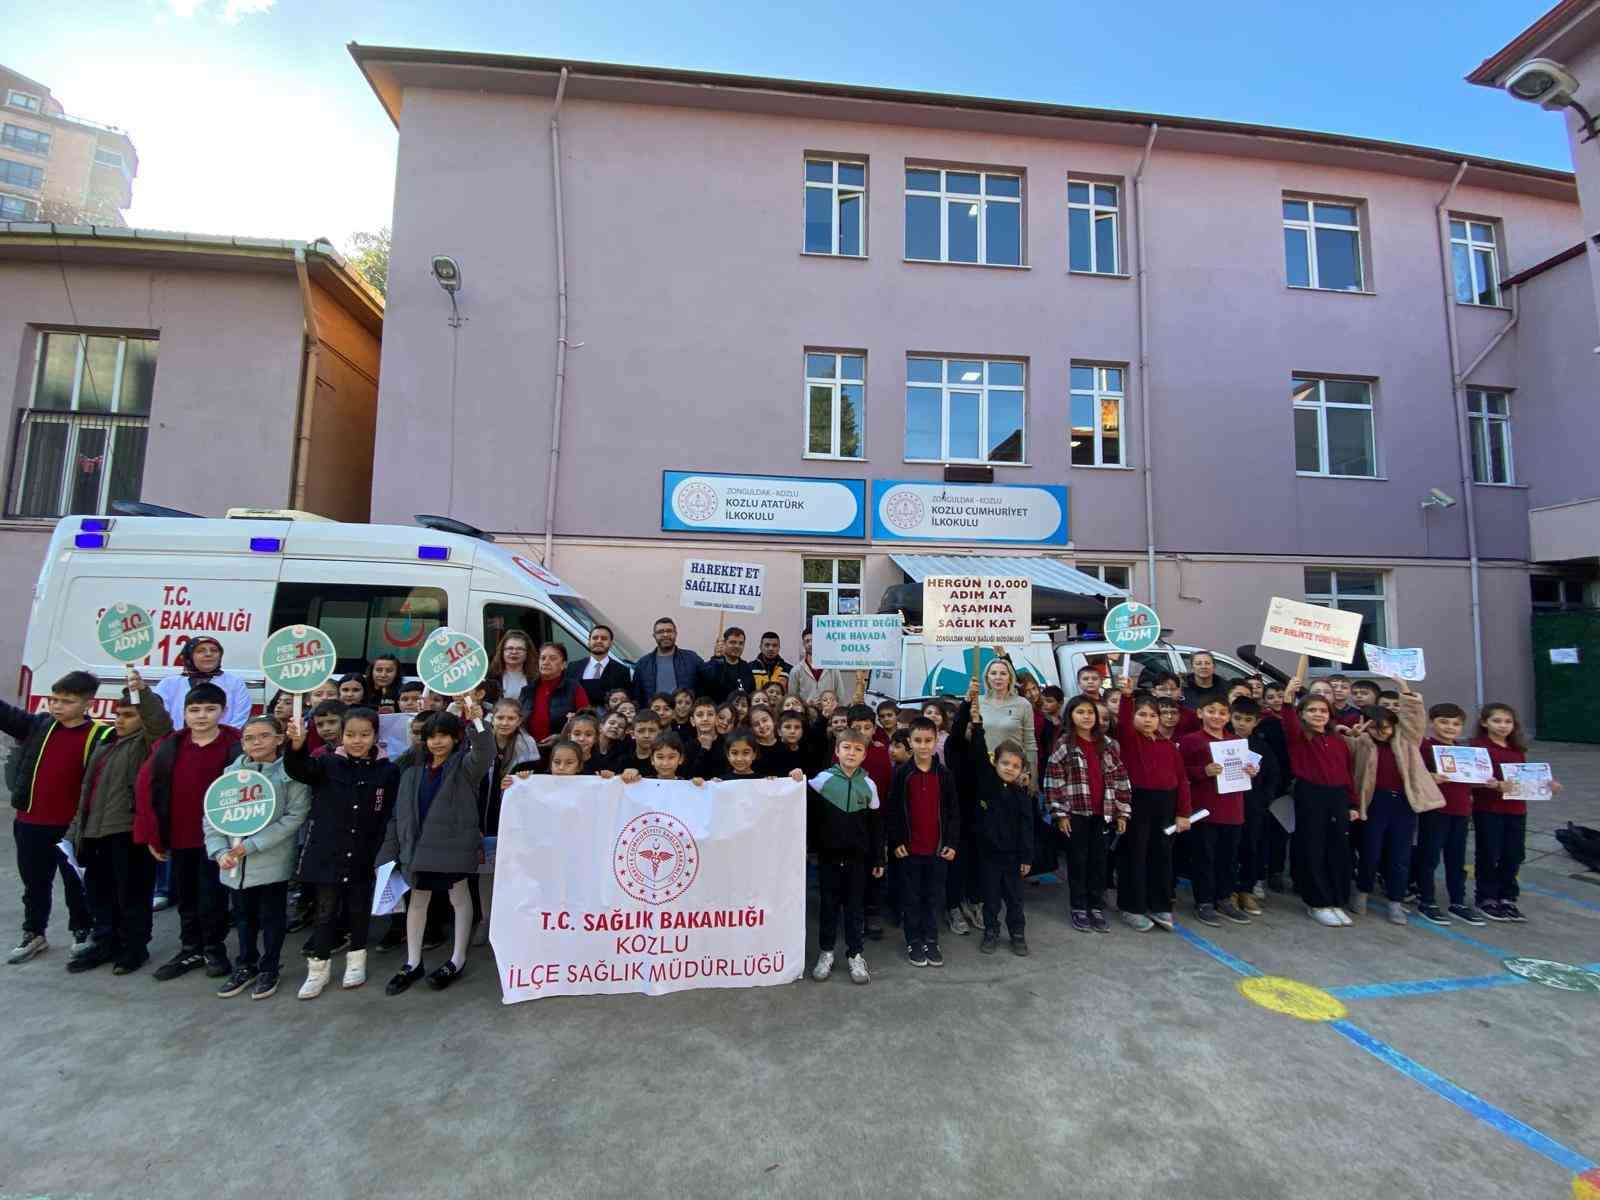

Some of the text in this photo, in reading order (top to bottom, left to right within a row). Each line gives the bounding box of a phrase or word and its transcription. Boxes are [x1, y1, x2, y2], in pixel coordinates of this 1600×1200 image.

[726, 498, 805, 510] KOZLU ATATÜRK
[725, 510, 774, 521] İLKOKULU
[931, 505, 1028, 517] KOZLU CUMHURİYET
[931, 517, 978, 528] İLKOKULU
[691, 562, 760, 579] HAREKET ET
[685, 577, 761, 597] SAĞLIKLI KAL
[927, 577, 1028, 588] HERGÜN 10.000
[163, 585, 192, 606] T.C.
[950, 590, 1007, 600] ADIM AT
[943, 604, 1013, 616] YAŞAMINA
[160, 608, 252, 633] BAKANLIĞI
[816, 617, 869, 628] İNTERNETTE
[938, 616, 1017, 628] SAĞLIK KAT
[826, 631, 886, 642] AÇIK HAVADA
[541, 906, 766, 932] T.C. SAĞLIK BAKANLIĞI
[616, 934, 690, 955] KOZLU
[509, 951, 785, 990] İLÇE SAĞLIK MÜDÜRLÜĞÜ
